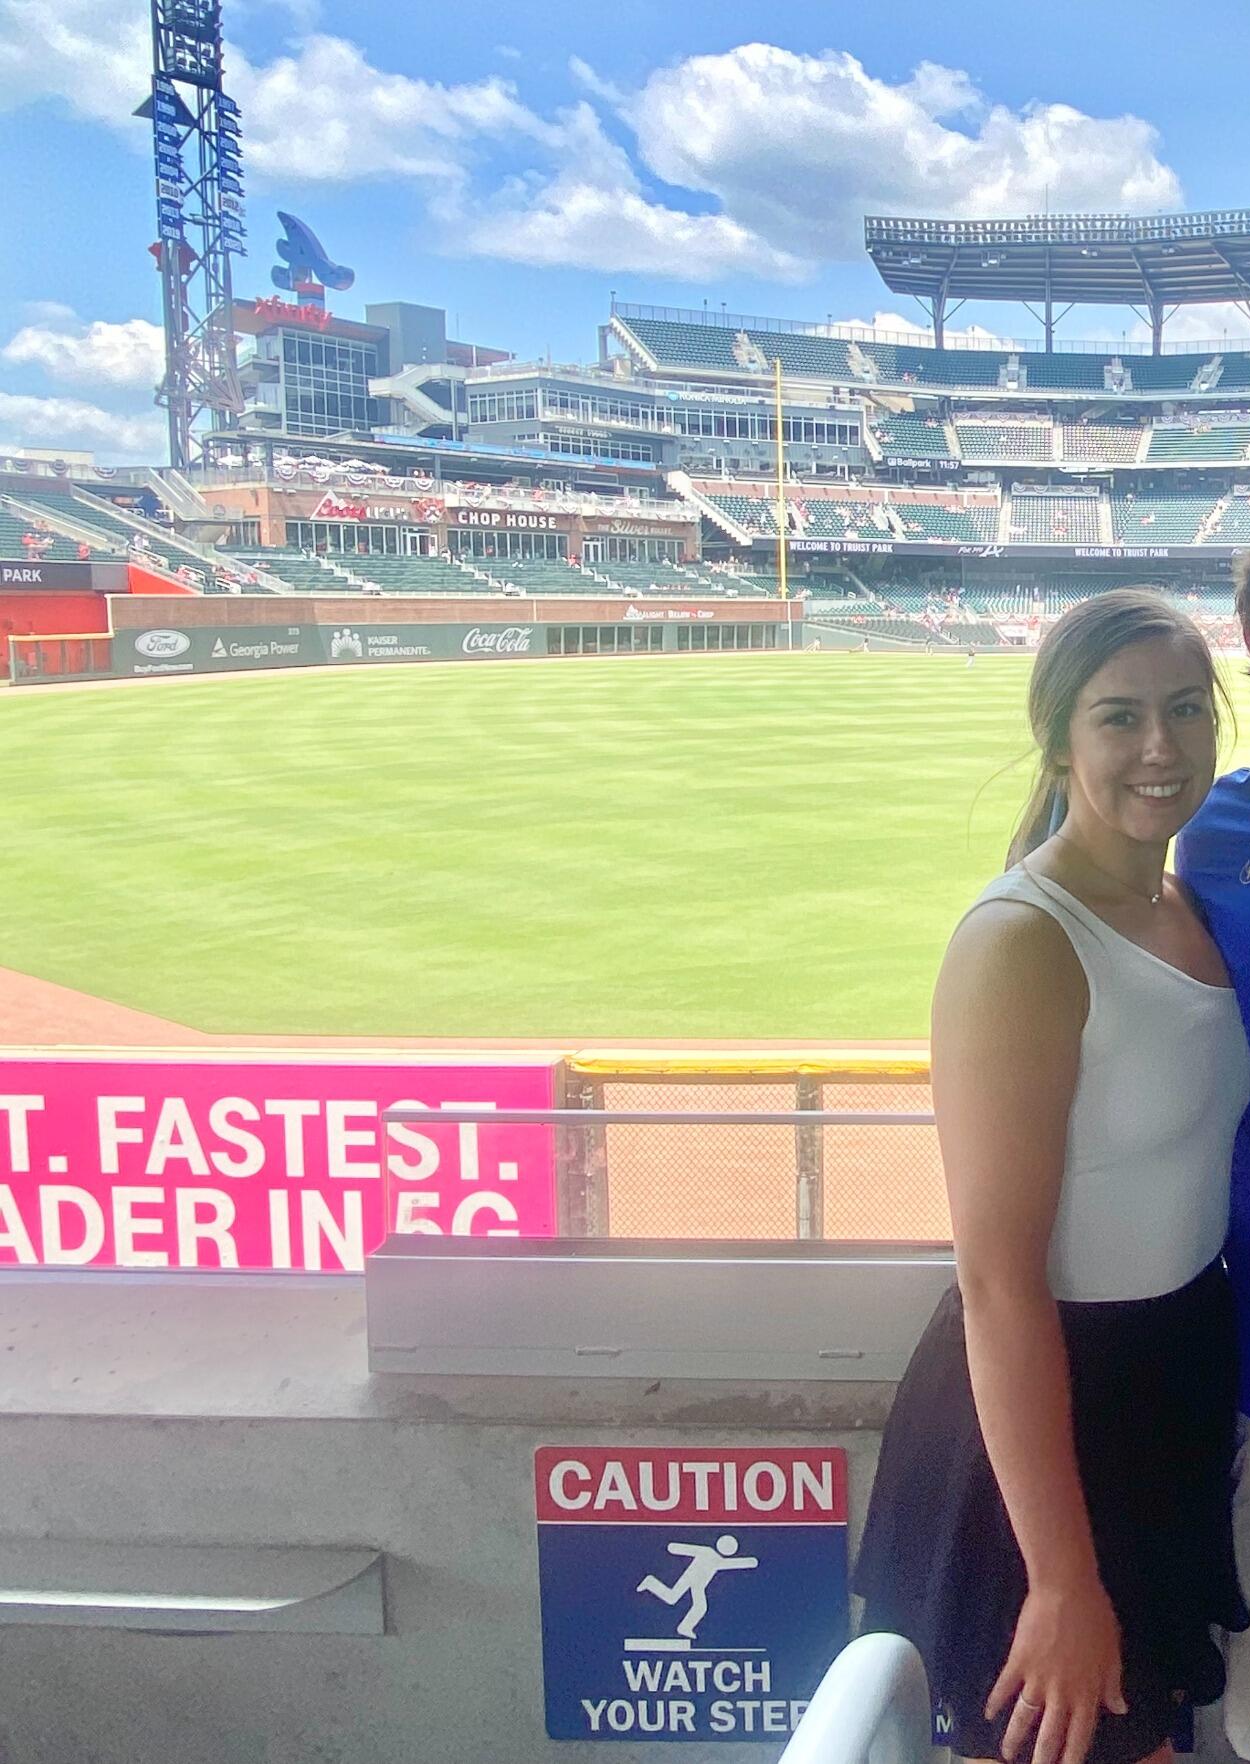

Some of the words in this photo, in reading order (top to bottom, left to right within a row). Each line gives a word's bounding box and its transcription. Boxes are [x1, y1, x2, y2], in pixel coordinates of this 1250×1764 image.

[897, 458, 931, 468] Ballpark
[940, 460, 959, 469] 11:57
[458, 511, 500, 526] CHOP
[506, 514, 557, 529] HOUSE
[790, 541, 828, 551] WELCOME
[830, 542, 840, 551] TO
[843, 543, 870, 552] TRUIST
[872, 544, 893, 552] PARK
[1075, 548, 1110, 556] WELCOME
[1112, 548, 1121, 556] TO
[1123, 548, 1148, 556] TRUIST
[1149, 548, 1169, 556] PARK
[3, 568, 42, 582] PARK
[147, 635, 178, 652] Ford
[368, 636, 397, 645] KAISER
[230, 642, 268, 658] Georgia
[270, 641, 299, 654] Power
[97, 1095, 518, 1182] FASTEST.
[268, 1189, 364, 1272] IN
[548, 1460, 834, 1512] CAUTION
[622, 1660, 771, 1694] WATCH
[581, 1699, 697, 1733] YOUR
